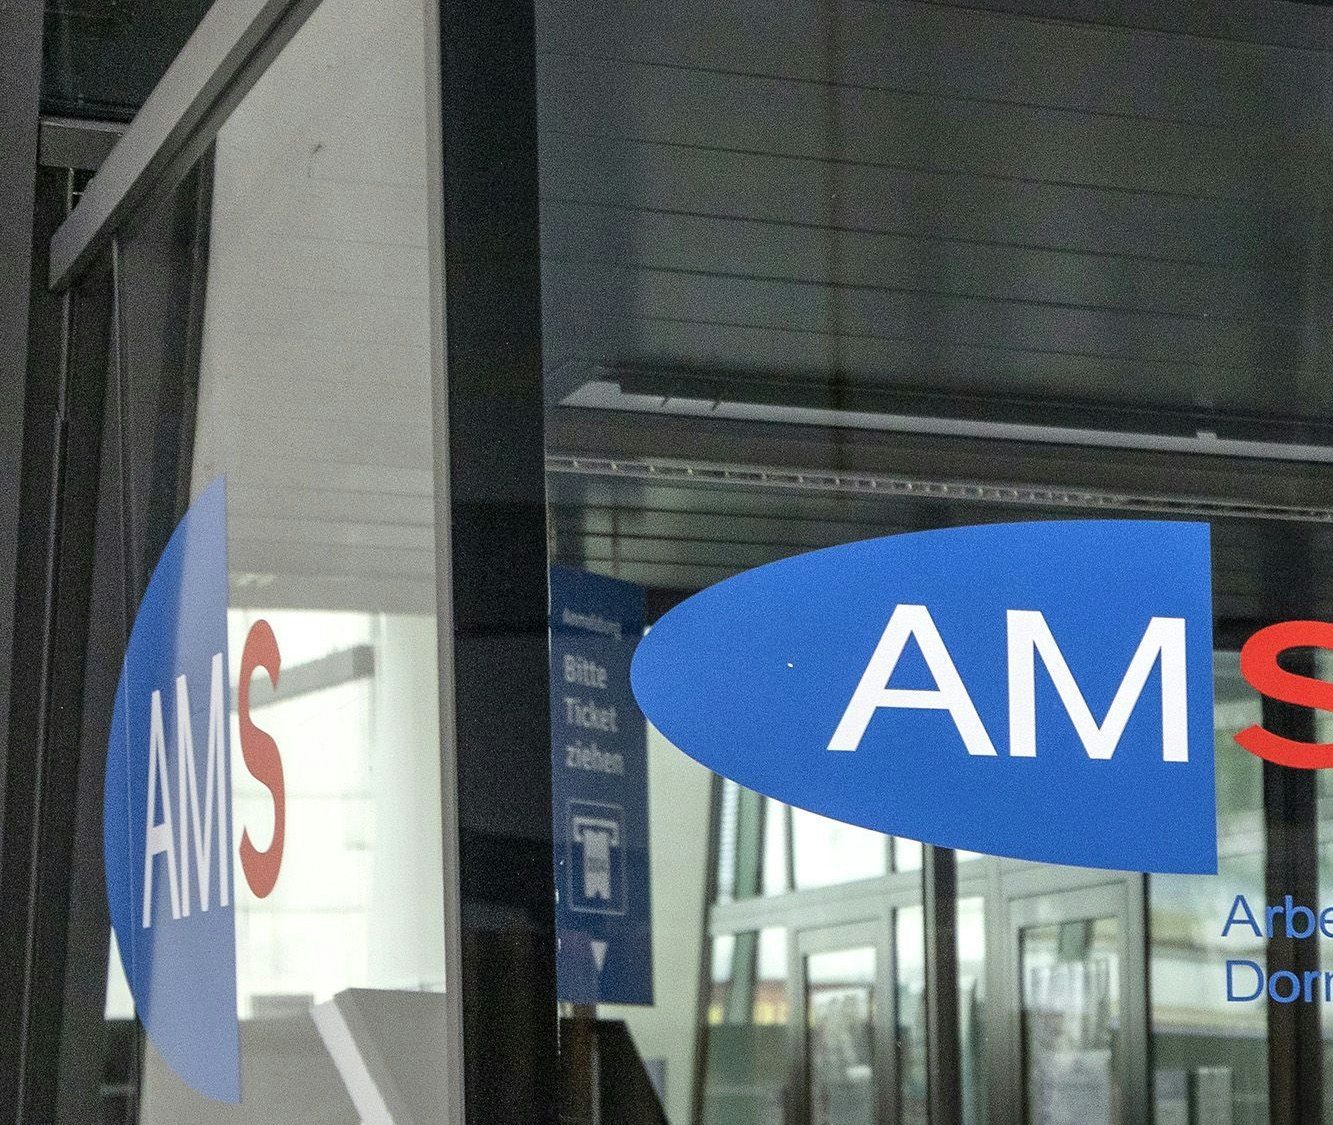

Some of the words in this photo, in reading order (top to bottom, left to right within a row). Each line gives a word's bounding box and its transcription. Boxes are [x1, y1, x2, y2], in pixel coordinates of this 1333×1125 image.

[563, 654, 609, 690] Bitte
[565, 697, 619, 733] Ticket
[143, 619, 285, 928] AMS
